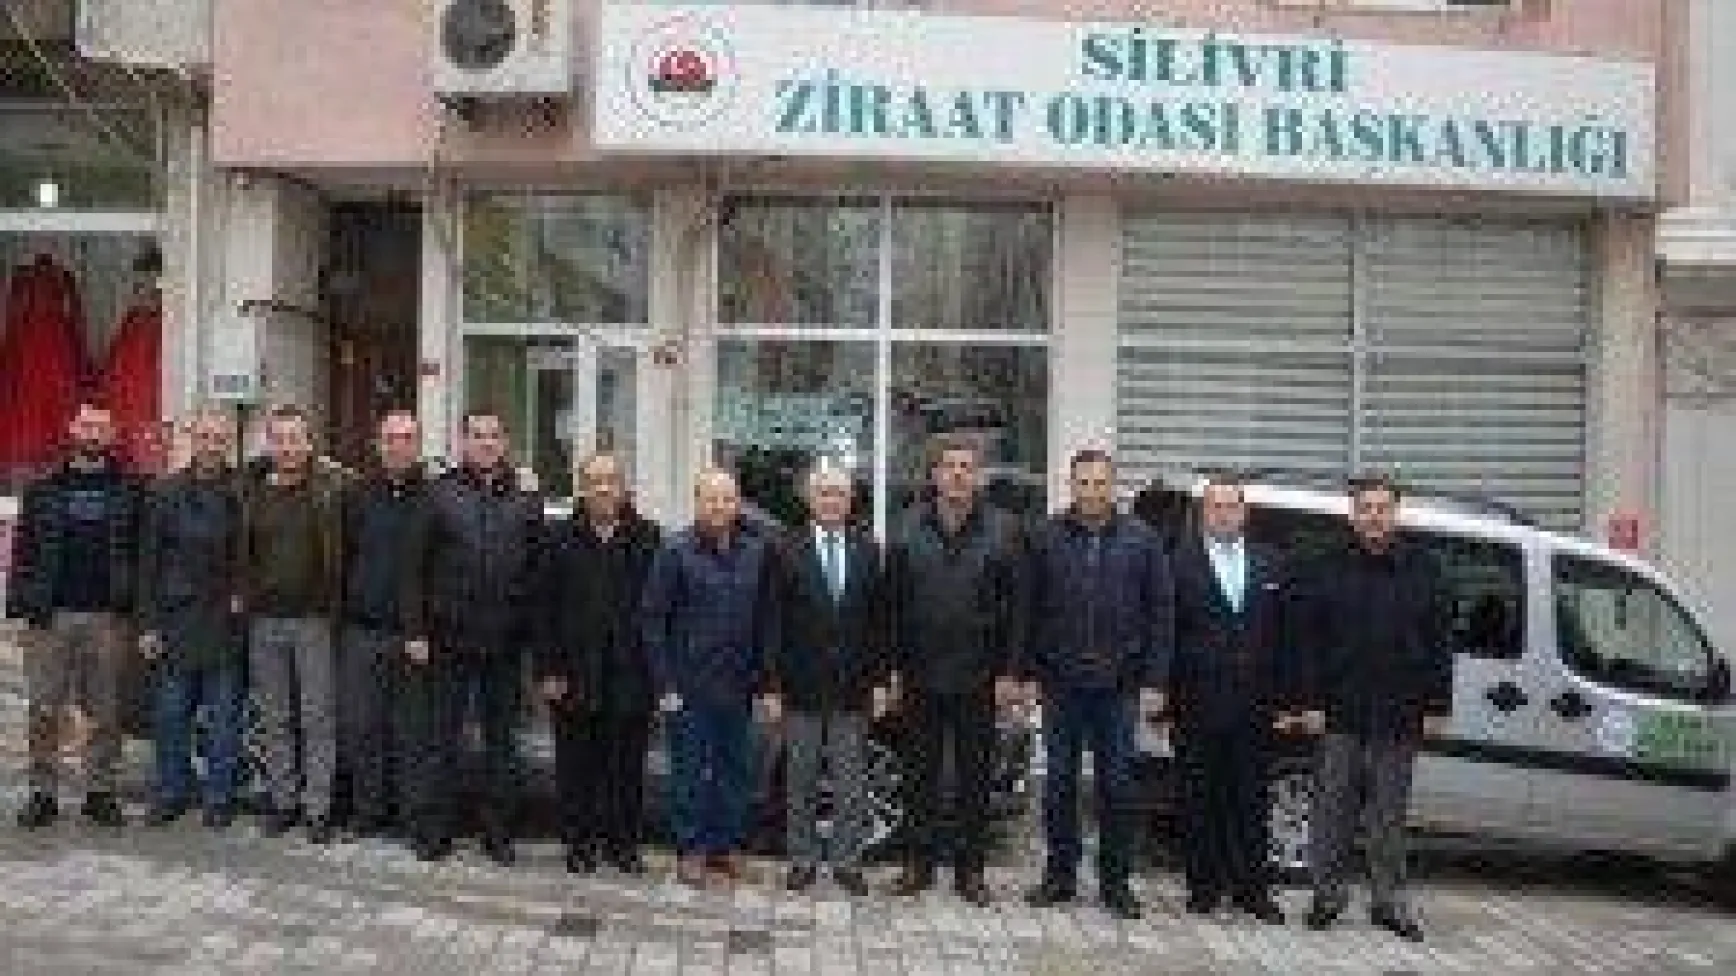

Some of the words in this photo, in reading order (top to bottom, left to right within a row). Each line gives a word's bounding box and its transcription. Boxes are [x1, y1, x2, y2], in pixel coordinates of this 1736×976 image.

[1080, 27, 1349, 93] SİLİVRİ
[774, 68, 1024, 141] ZİRAAT
[1046, 92, 1240, 156] ODASI
